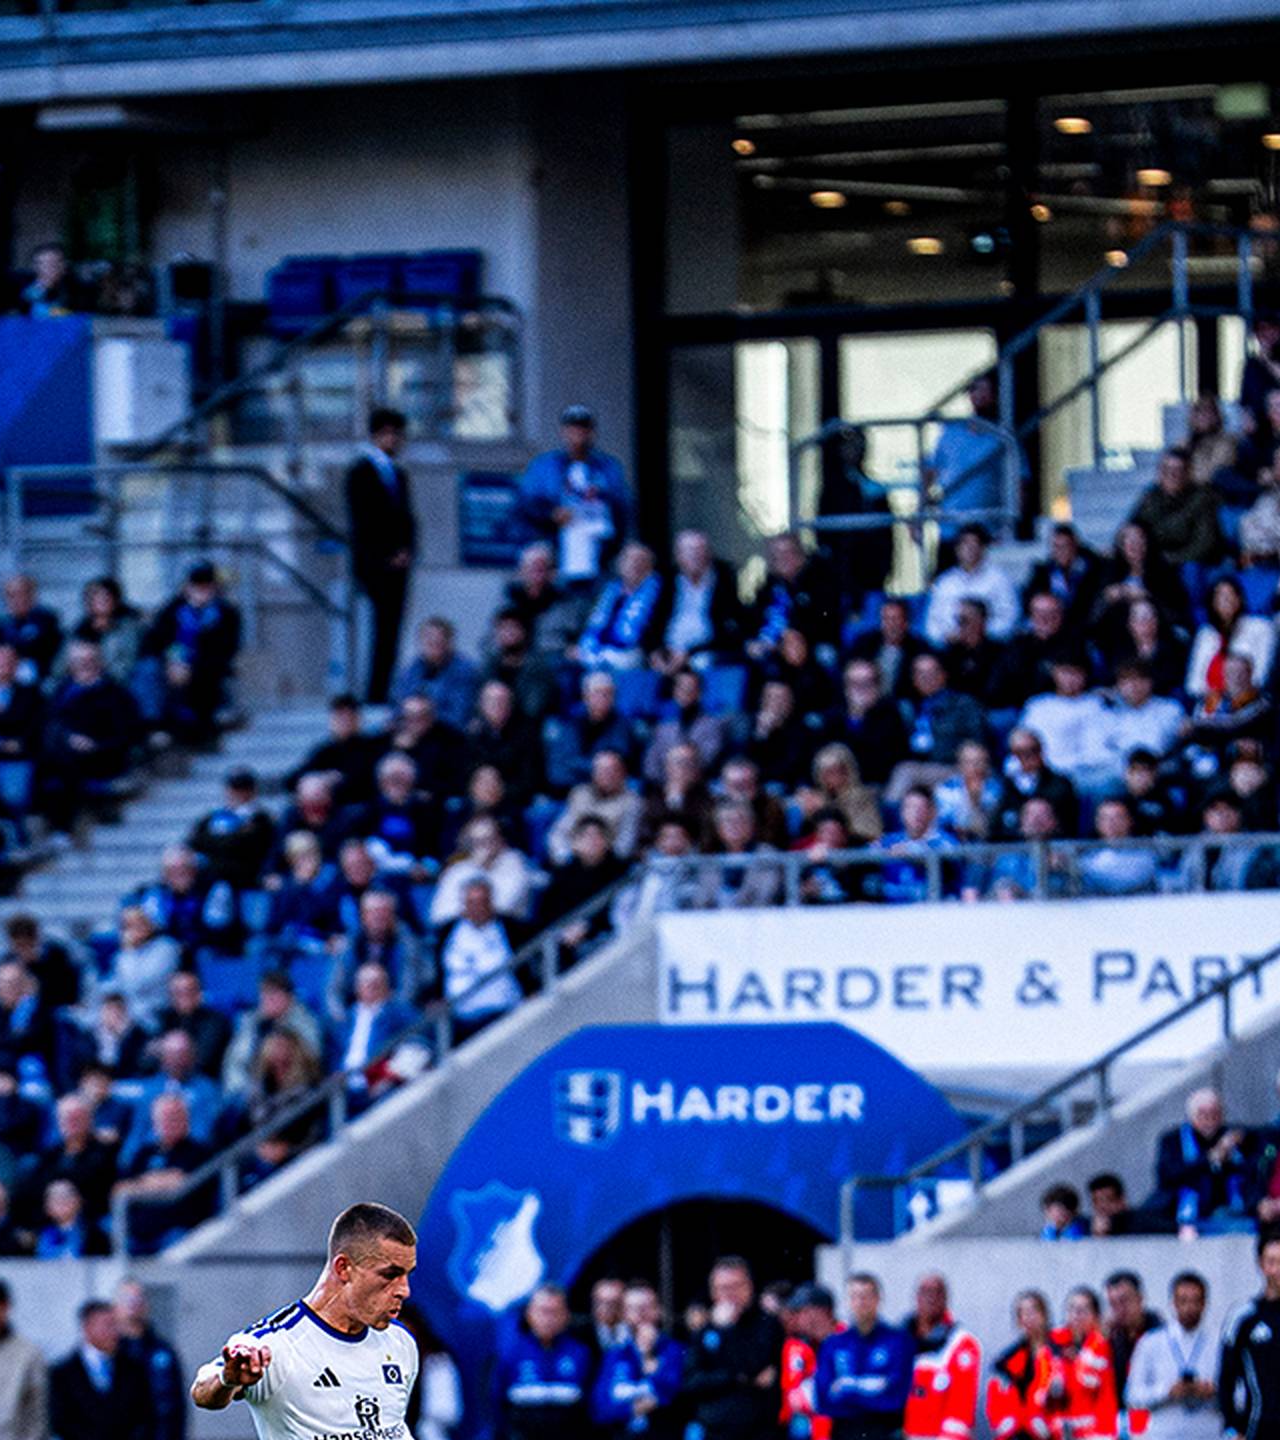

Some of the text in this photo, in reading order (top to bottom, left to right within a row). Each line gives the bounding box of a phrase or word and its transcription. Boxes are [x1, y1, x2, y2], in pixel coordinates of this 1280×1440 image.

[667, 963, 983, 1013] HARDER
[1015, 961, 1060, 1005] &
[631, 1083, 865, 1122] HARDER
